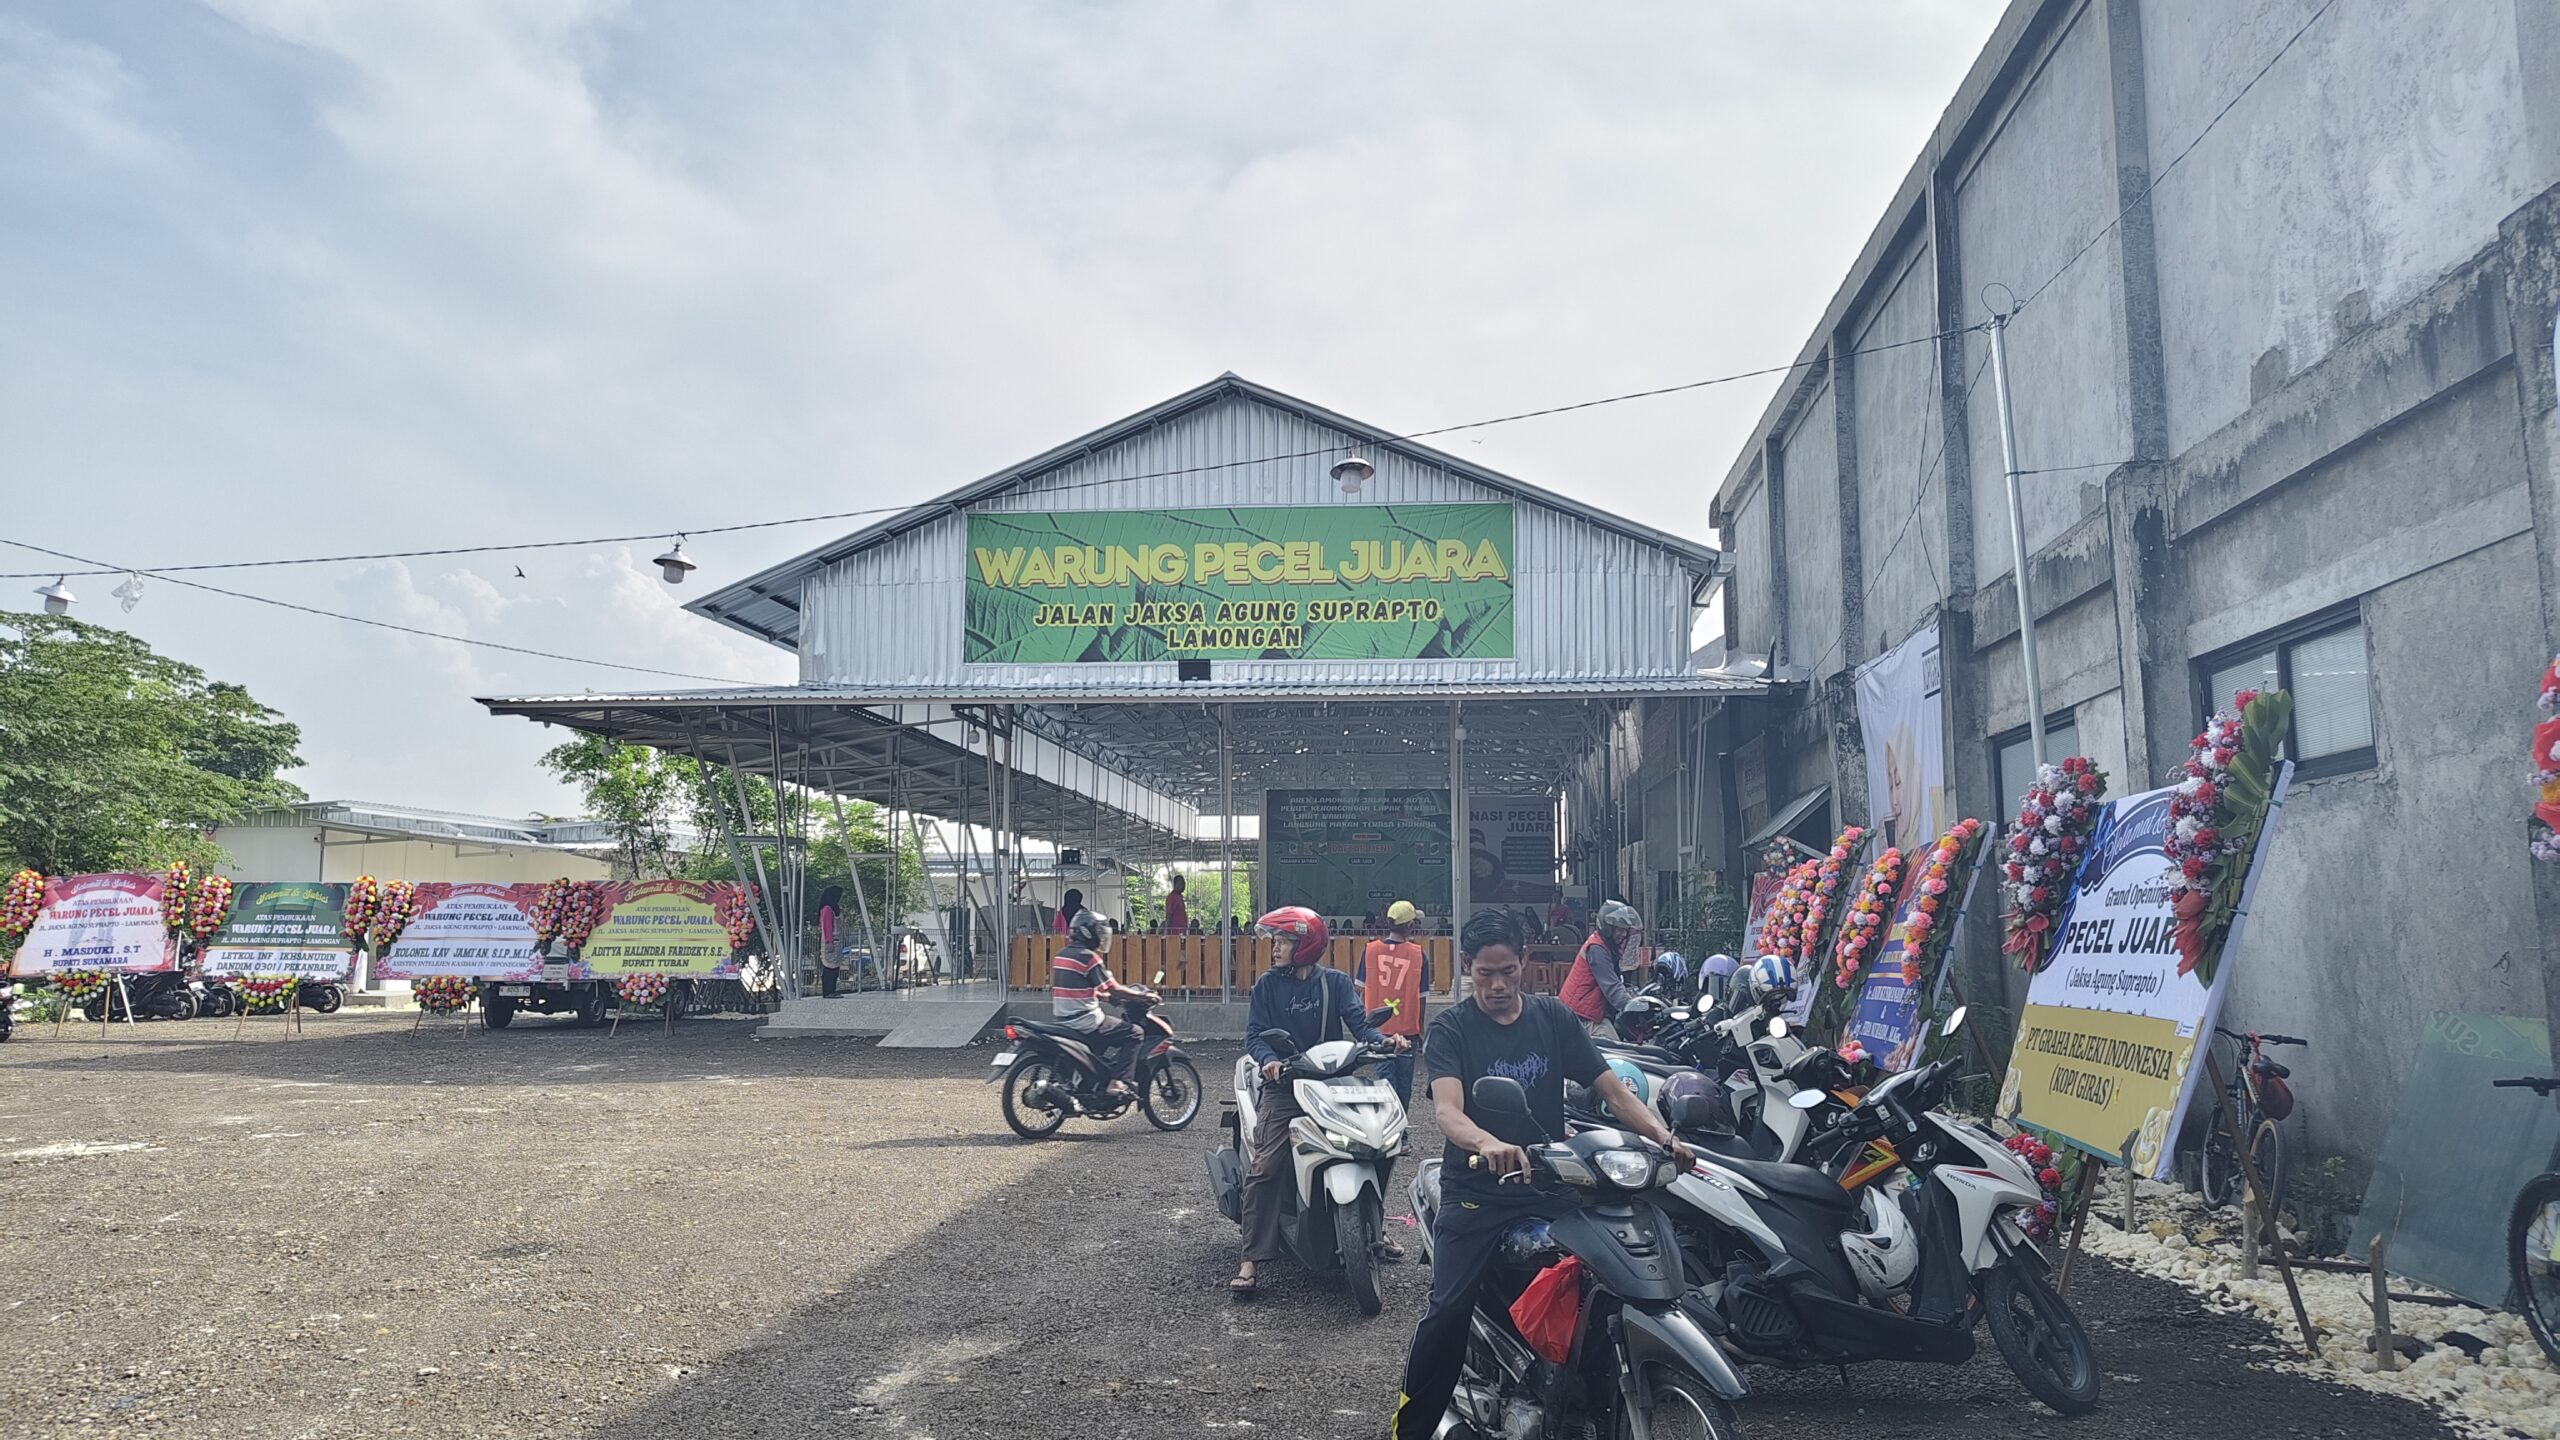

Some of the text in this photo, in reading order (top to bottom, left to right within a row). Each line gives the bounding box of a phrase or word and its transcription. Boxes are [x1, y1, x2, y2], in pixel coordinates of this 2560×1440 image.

[976, 537, 1509, 589] WARUNG PECEL JUARA
[1034, 598, 1439, 626] JALAN JAKSA AGUNG SUPRAPTO
[1166, 626, 1303, 650] LAMONGAN
[1470, 811, 1553, 821] NASI PECEL
[1507, 822, 1554, 832] JUARA
[2102, 807, 2159, 875] Selamat
[624, 883, 665, 901] Selamat
[676, 883, 706, 899] Sukses
[2105, 882, 2167, 910] Grand Opening
[49, 906, 154, 920] WARUNG PECEL JUARA
[424, 913, 525, 921] WARUNG PECEL JUARA
[613, 915, 713, 925] WARUNG PECEL JUARA
[231, 924, 336, 934] WARUNG PECEL JUARA
[2062, 916, 2182, 955] PECEL JUAR
[222, 951, 255, 960] LETKOL
[280, 951, 336, 961] IKHSANUDIN
[394, 947, 430, 958] KOLONEL
[431, 947, 450, 958] KAV
[591, 946, 622, 957] ADITYA
[623, 946, 666, 957] HALINDRA
[52, 957, 128, 967] BUPATI SUKAMARA
[216, 962, 250, 971] DANDIM
[254, 963, 276, 971] 0301
[284, 963, 337, 972] PEKANBARU
[622, 959, 690, 967] BUPATI TUBAN
[1378, 954, 1410, 990] 57
[2091, 969, 2117, 996] Agung
[2025, 1027, 2173, 1081] PT GRAHA REJEKI INDONESIA
[2049, 1063, 2115, 1112] (KOPI GIRAS)
[1946, 1173, 1977, 1191] HONDA
